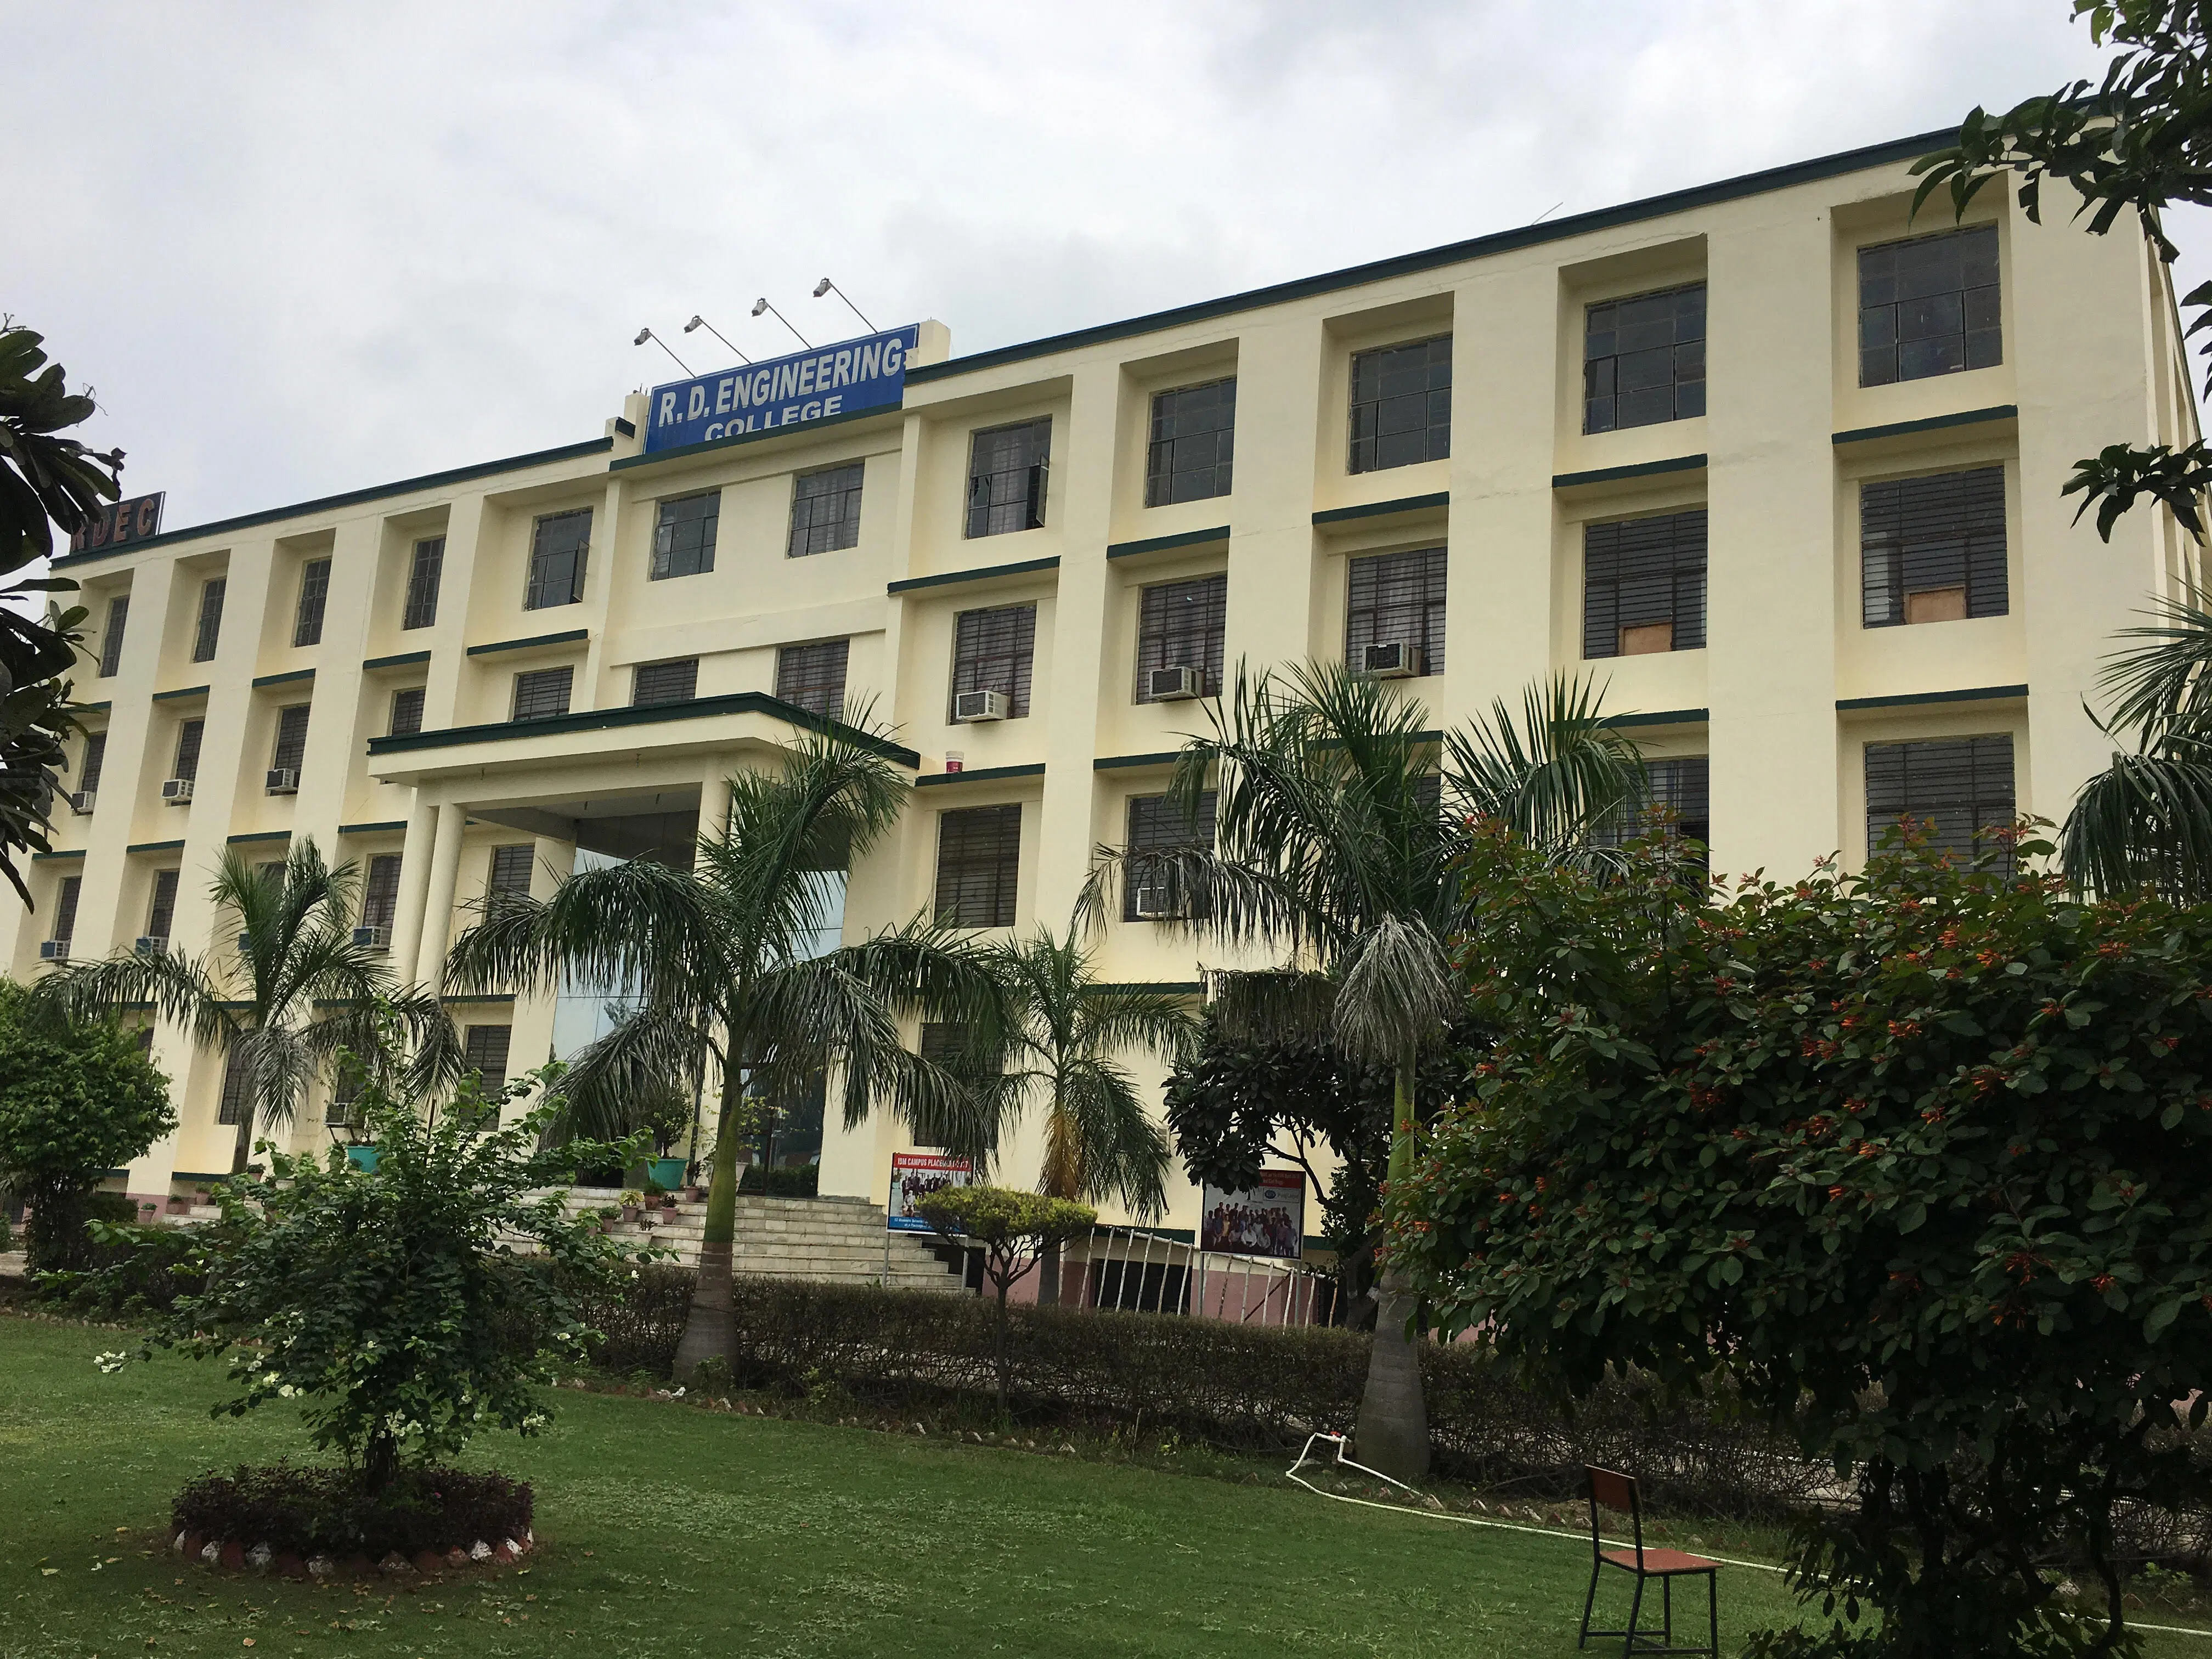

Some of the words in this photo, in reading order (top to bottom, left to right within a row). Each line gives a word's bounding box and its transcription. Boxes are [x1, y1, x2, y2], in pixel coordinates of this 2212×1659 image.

[715, 338, 902, 415] ENGINEERING
[704, 394, 843, 441] COLLEGE
[907, 1158, 927, 1166] CAMPUS
